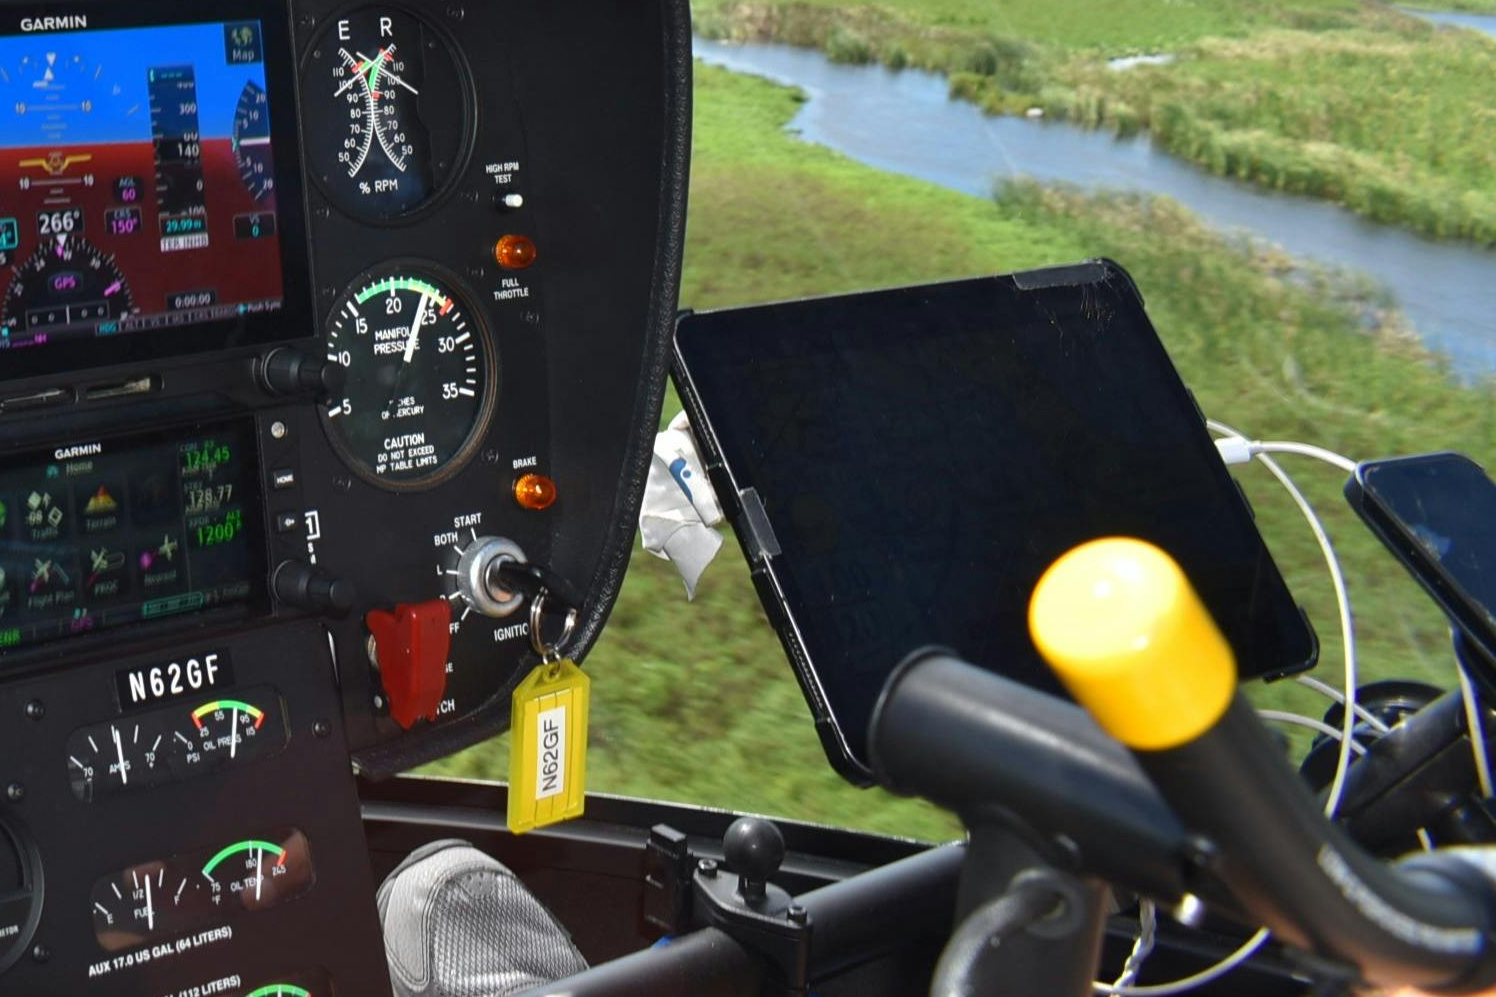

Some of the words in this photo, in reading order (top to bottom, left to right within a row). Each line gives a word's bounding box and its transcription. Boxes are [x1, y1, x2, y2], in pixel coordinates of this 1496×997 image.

[20, 15, 87, 33] GARMIN
[338, 20, 351, 40] E
[380, 17, 393, 37] R
[232, 48, 255, 63] Map
[332, 67, 344, 77] 110
[393, 62, 404, 72] 110
[346, 92, 358, 103] 90
[384, 90, 396, 100] 90
[179, 103, 197, 115] 300
[350, 108, 361, 119] 80
[383, 105, 395, 115] 80
[350, 124, 360, 134] 70
[387, 120, 398, 130] 70
[344, 138, 356, 149] 60
[394, 133, 405, 143] 60
[177, 143, 200, 158] 140
[338, 152, 350, 162] 50
[486, 164, 503, 174] HIGH
[504, 162, 520, 172] RPM
[494, 174, 512, 184] TEST
[359, 181, 370, 194] %
[375, 179, 399, 192] RPM
[122, 188, 136, 201] 60
[39, 210, 80, 234] 266°
[54, 276, 76, 290] GPS
[502, 277, 519, 288] FULL
[493, 287, 529, 300] THROTTLE
[385, 298, 402, 314] 20
[420, 309, 437, 326] 25
[355, 318, 368, 334] 15
[438, 337, 455, 353] 30
[338, 351, 351, 366] 10
[442, 383, 459, 400] 35
[342, 399, 352, 414] 5
[384, 432, 425, 450] CAUTION
[54, 443, 101, 460] GARMIN
[377, 454, 387, 463] DO
[391, 450, 404, 460] NOT
[408, 444, 435, 457] EXCEED
[66, 461, 94, 475] Home
[389, 459, 413, 471] TABLE
[416, 455, 438, 467] LIMITS
[512, 456, 537, 469] BRAKE
[454, 512, 482, 528] START
[197, 524, 234, 547] 1200
[434, 531, 459, 547] BOTH
[436, 565, 443, 576] L
[128, 654, 220, 703] N62GF
[203, 740, 216, 751] OIL
[186, 752, 200, 764] PSI
[542, 719, 560, 792] N62GF
[272, 865, 286, 877] 245
[230, 881, 243, 892] OIL
[88, 960, 111, 978] AUX
[113, 953, 134, 970] 17.0
[135, 950, 150, 963] US
[152, 942, 174, 959] GAL
[176, 937, 191, 954] (64
[193, 926, 233, 947] LITERS)
[201, 974, 241, 995] LITERS)
